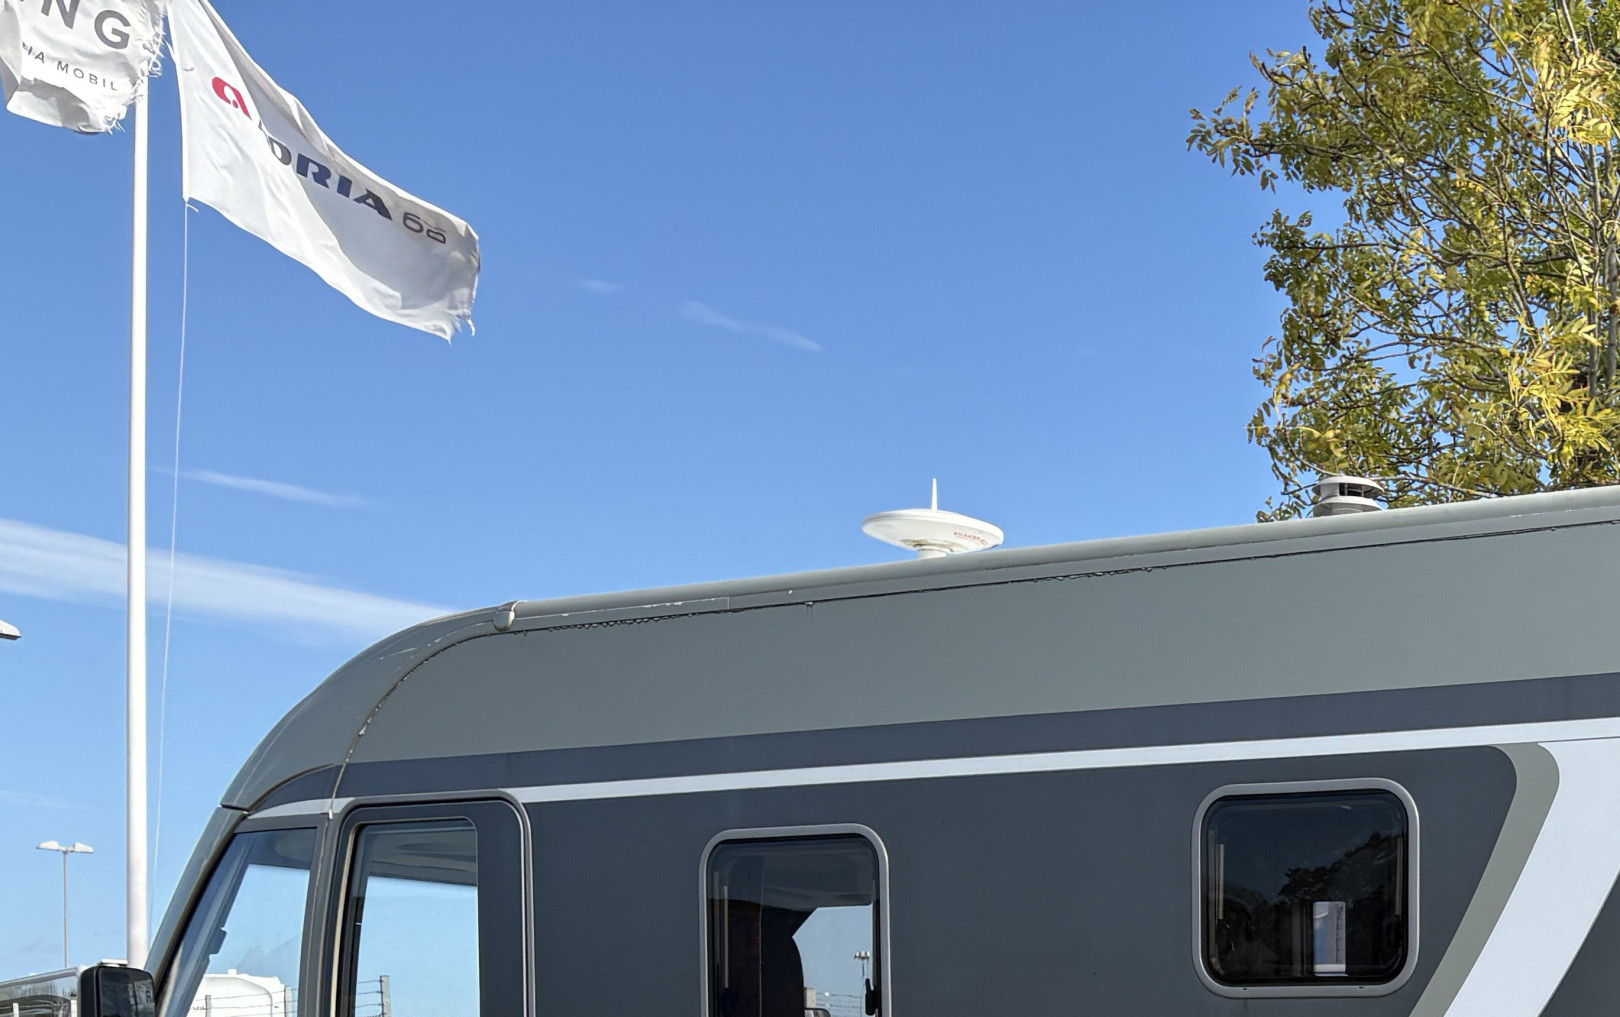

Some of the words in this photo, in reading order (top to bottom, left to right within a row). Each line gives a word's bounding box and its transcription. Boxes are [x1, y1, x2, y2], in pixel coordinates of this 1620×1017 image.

[20, 0, 132, 50] NG
[56, 60, 118, 91] MOBIL
[258, 119, 393, 222] DRIA
